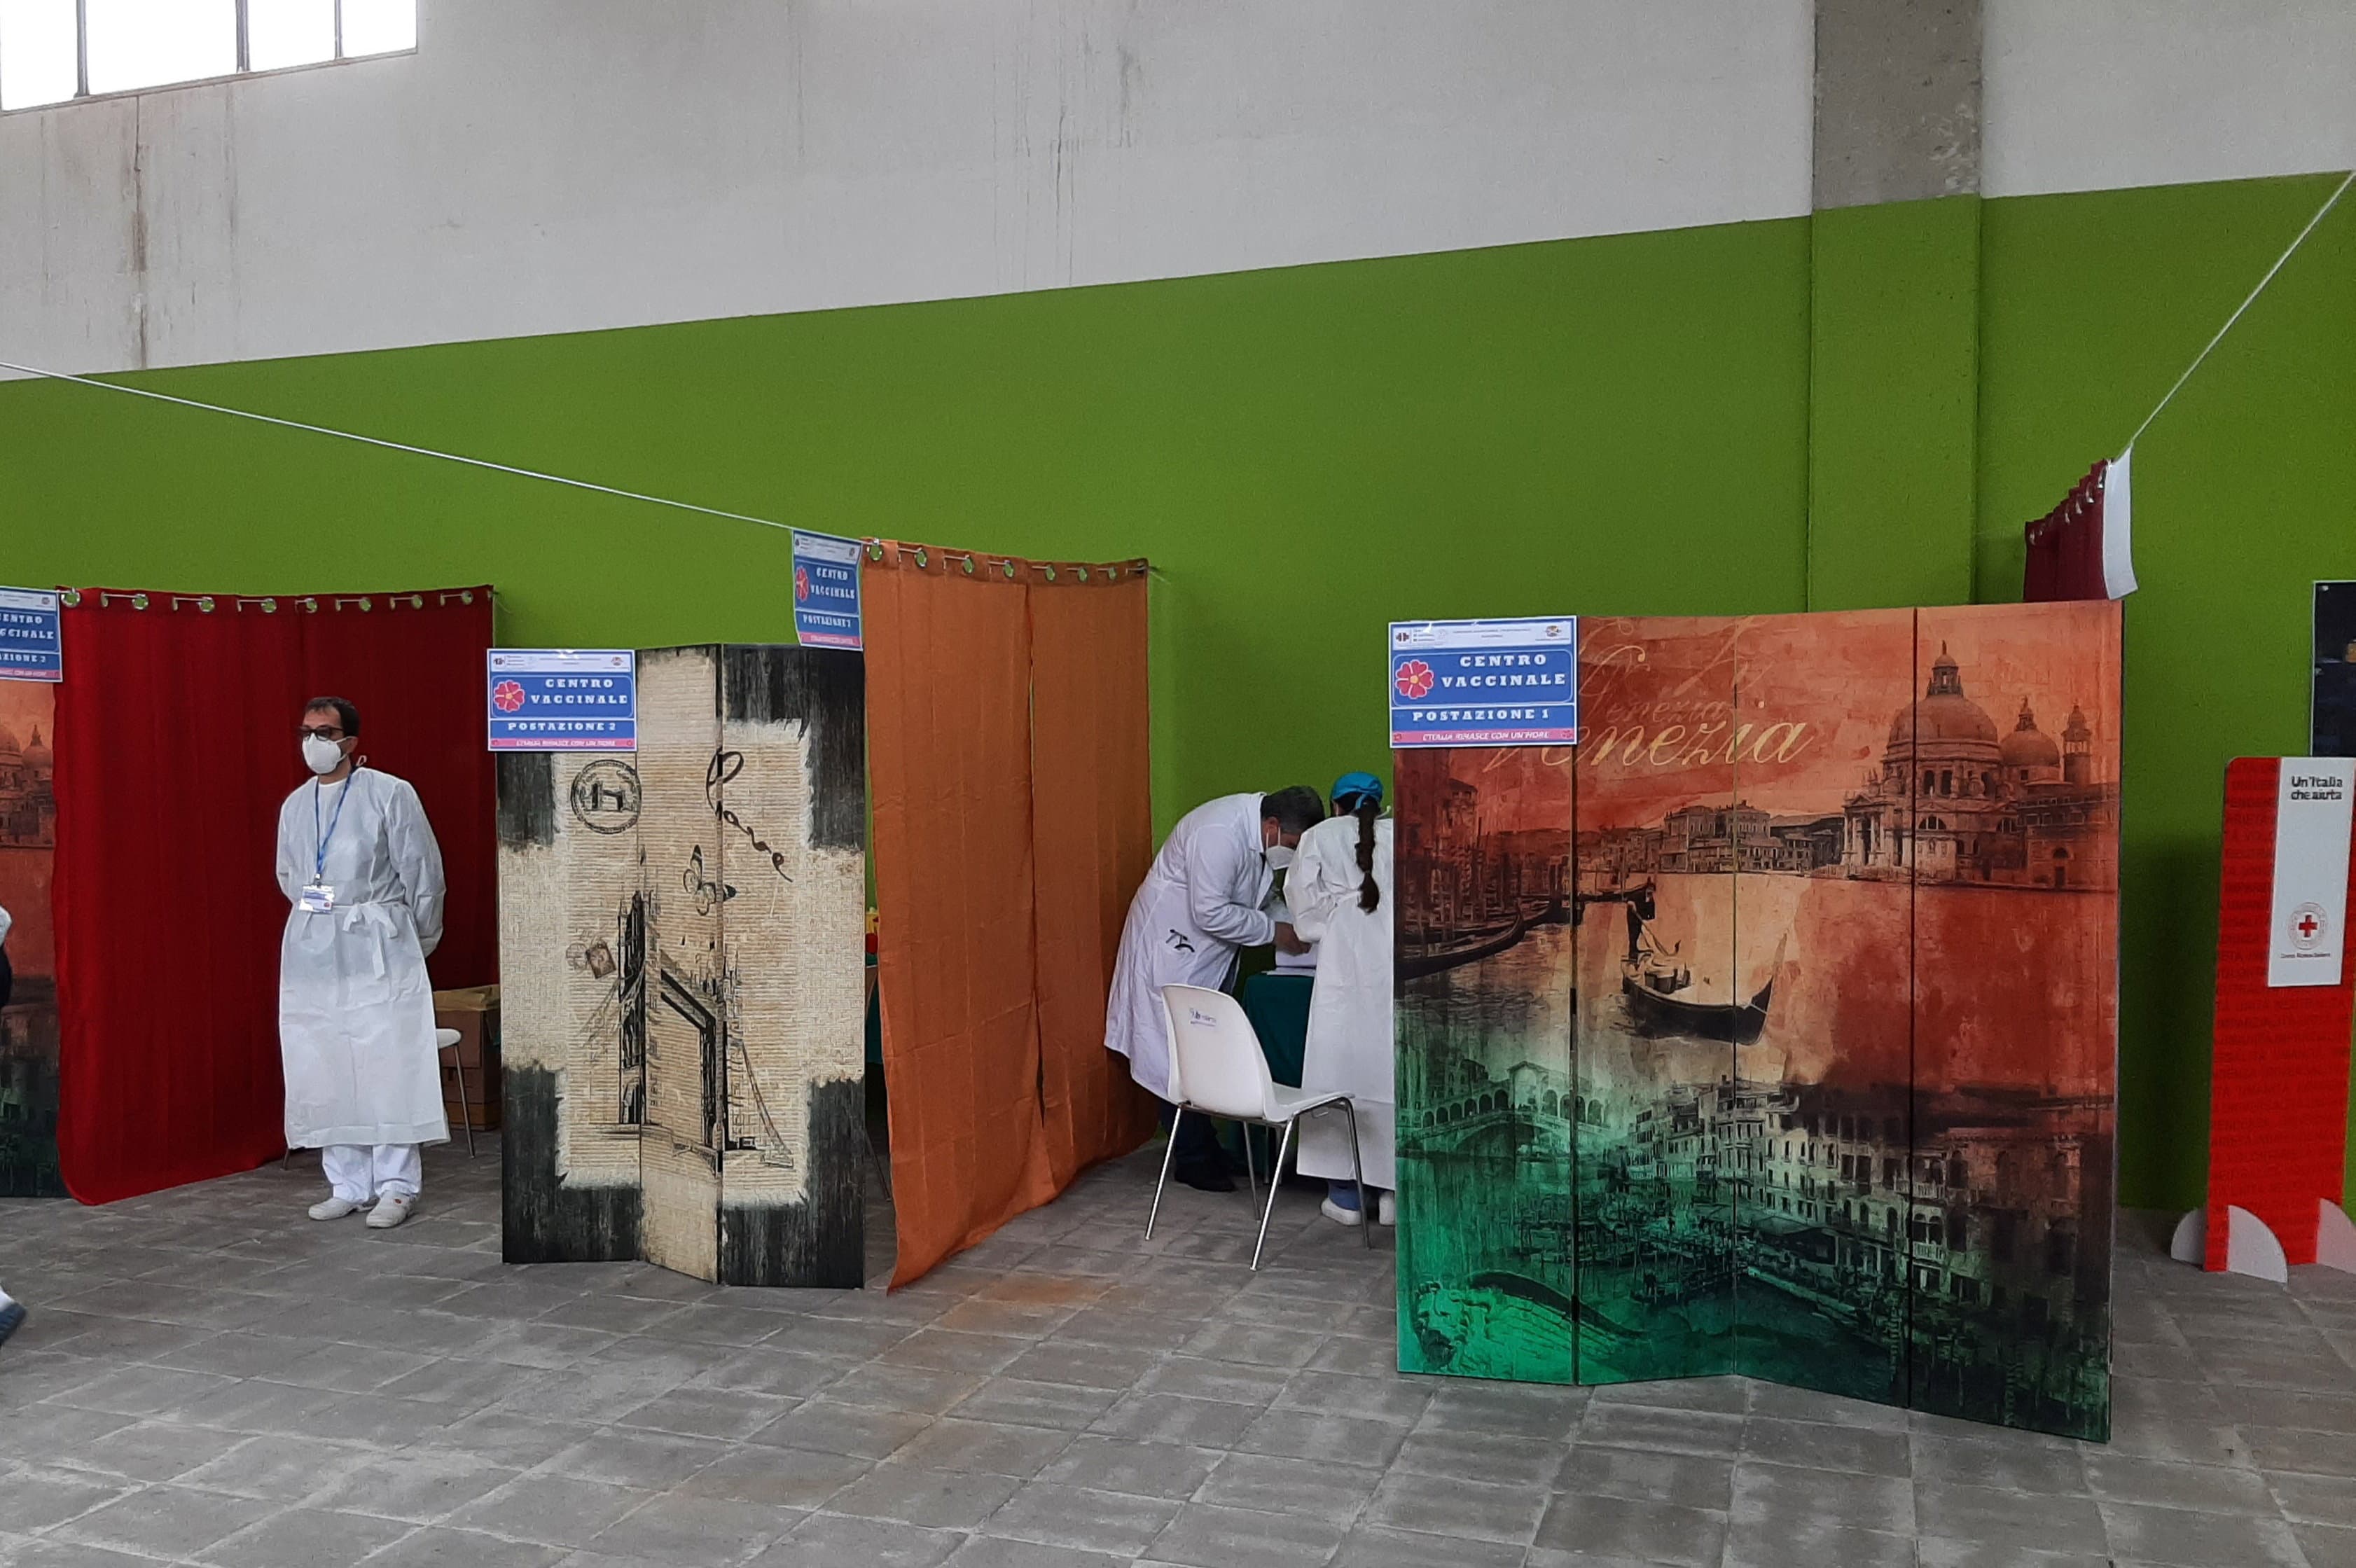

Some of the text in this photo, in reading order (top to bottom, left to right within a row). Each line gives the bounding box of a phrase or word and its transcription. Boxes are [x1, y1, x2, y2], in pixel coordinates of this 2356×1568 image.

[817, 567, 848, 581] CENTRO
[810, 585, 855, 600] VACCINALE
[0, 613, 43, 625] ENTRO
[1460, 654, 1547, 668] CENTRO
[545, 679, 614, 688] CENTRO
[1441, 674, 1566, 688] VACCINALE
[530, 695, 628, 705] VACCINALE
[1413, 709, 1550, 722] POSTAZIONE 1
[508, 722, 616, 732] POSTAZIONE 2
[1541, 702, 1814, 766] enezia
[2291, 776, 2343, 788] Un'Italia
[2291, 790, 2310, 800] che
